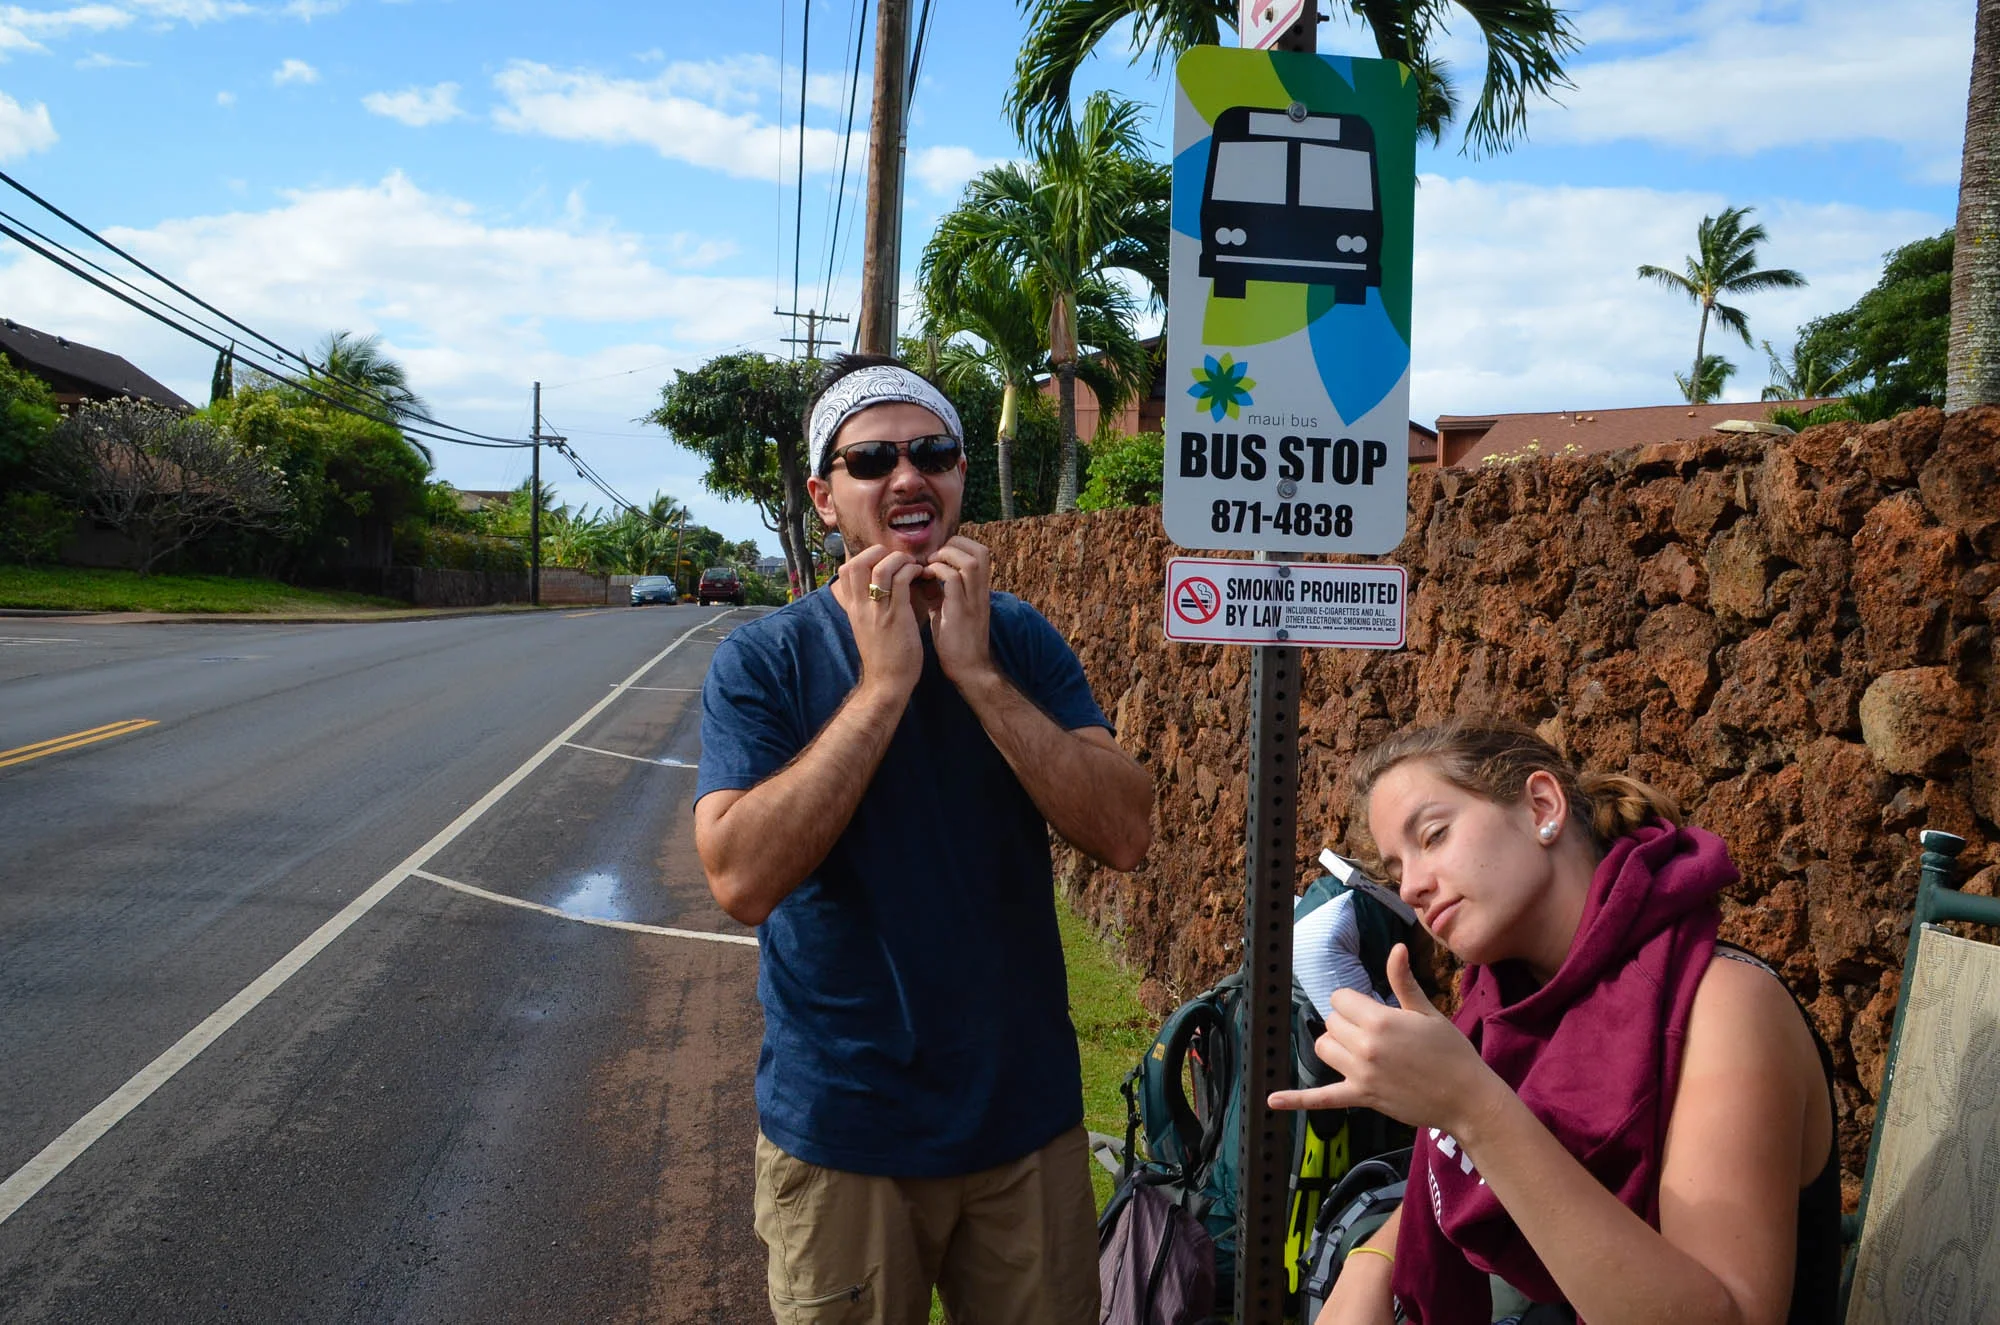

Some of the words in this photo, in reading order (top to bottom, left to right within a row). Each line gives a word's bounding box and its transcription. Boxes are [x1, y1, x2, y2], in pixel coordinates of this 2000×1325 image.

[1248, 413, 1285, 426] maui
[1291, 413, 1318, 428] bus
[1180, 431, 1267, 481] BUS
[1278, 435, 1387, 485] STOP
[1211, 499, 1353, 538] 871-4838
[1226, 578, 1295, 602] SMOKING
[1300, 580, 1398, 605] PROHIBITED
[1225, 604, 1248, 626] BY
[1253, 605, 1282, 628] LAW
[1285, 606, 1318, 615] INCLUDING
[1319, 607, 1360, 616] E-CIGARETTES
[1361, 608, 1374, 616] AND
[1375, 608, 1386, 617] ALL
[1285, 615, 1305, 624] OTHER
[1306, 616, 1342, 625] ELECTRONIC
[1343, 617, 1371, 626] SMOKING
[1372, 618, 1396, 627] DEVICES
